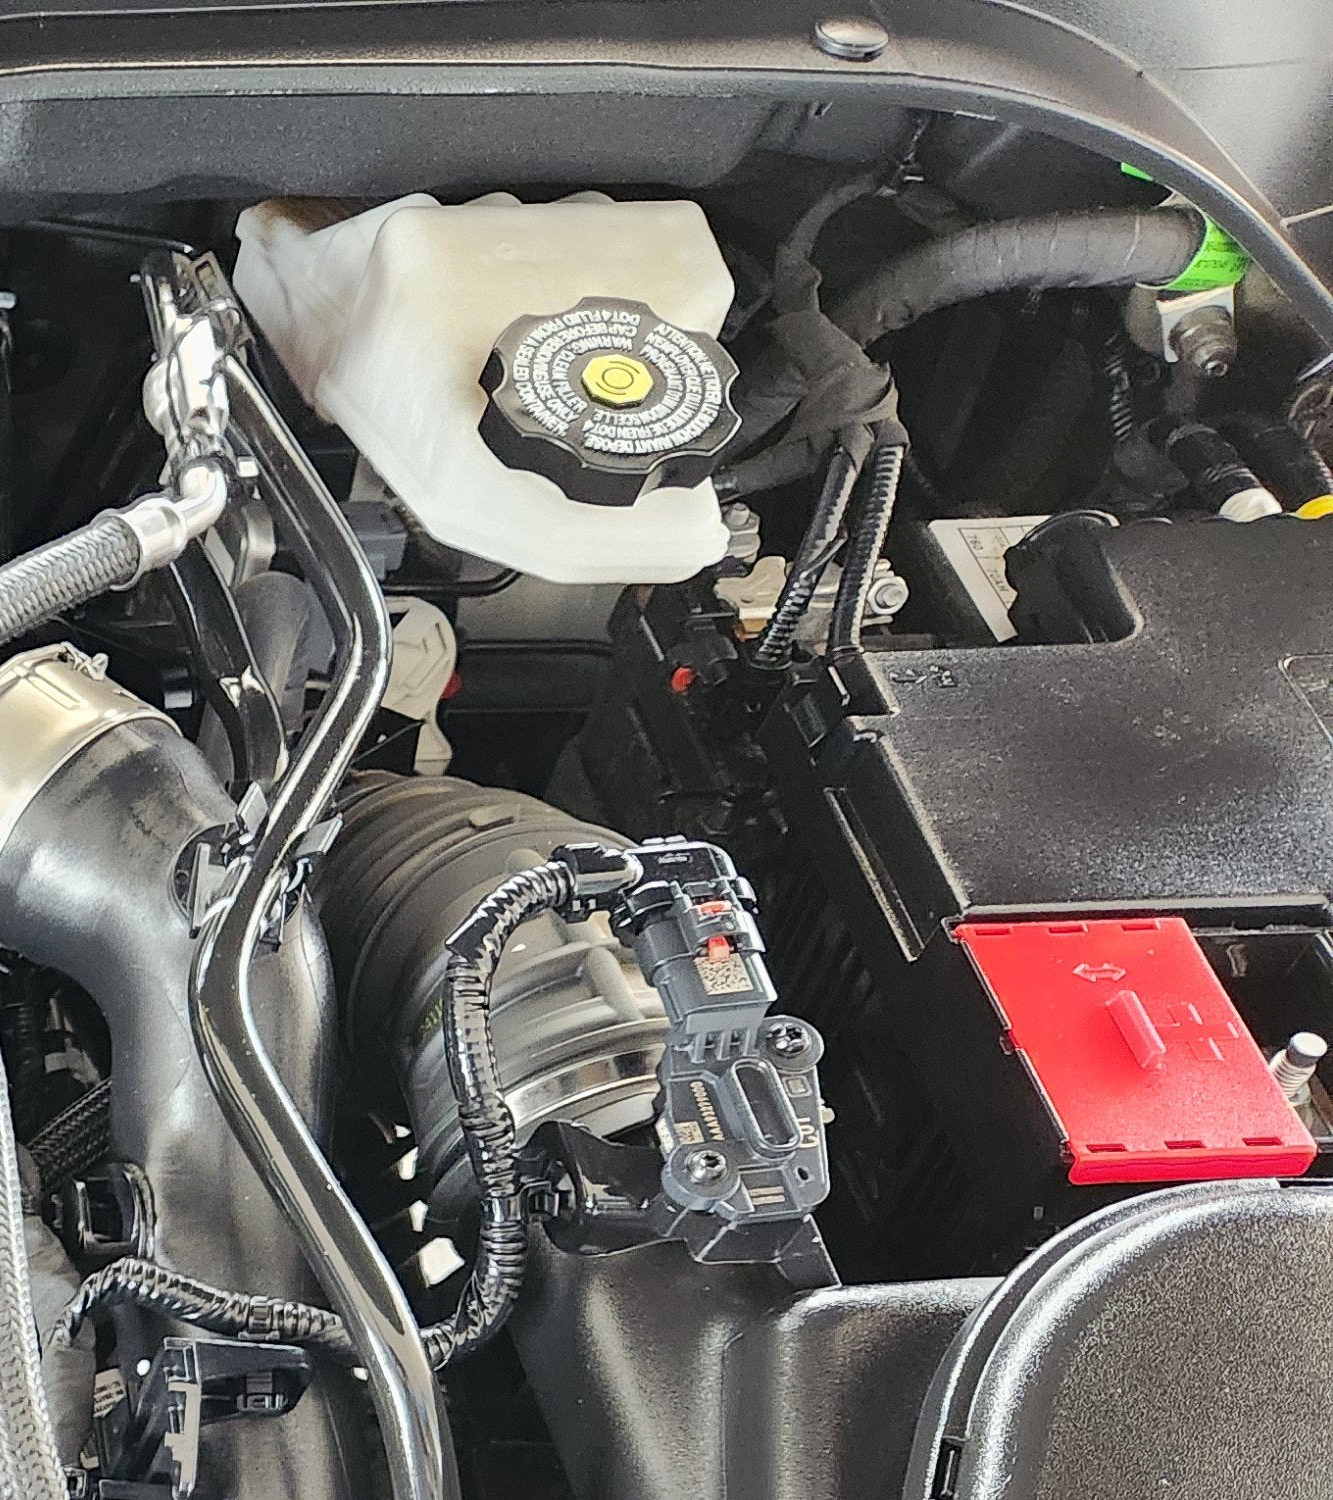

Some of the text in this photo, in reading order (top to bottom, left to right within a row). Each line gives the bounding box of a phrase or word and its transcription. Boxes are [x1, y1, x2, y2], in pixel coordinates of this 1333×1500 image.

[563, 310, 601, 325] FLUID
[612, 311, 640, 325] DOT
[609, 324, 637, 337] CAP
[591, 423, 616, 439] DOT
